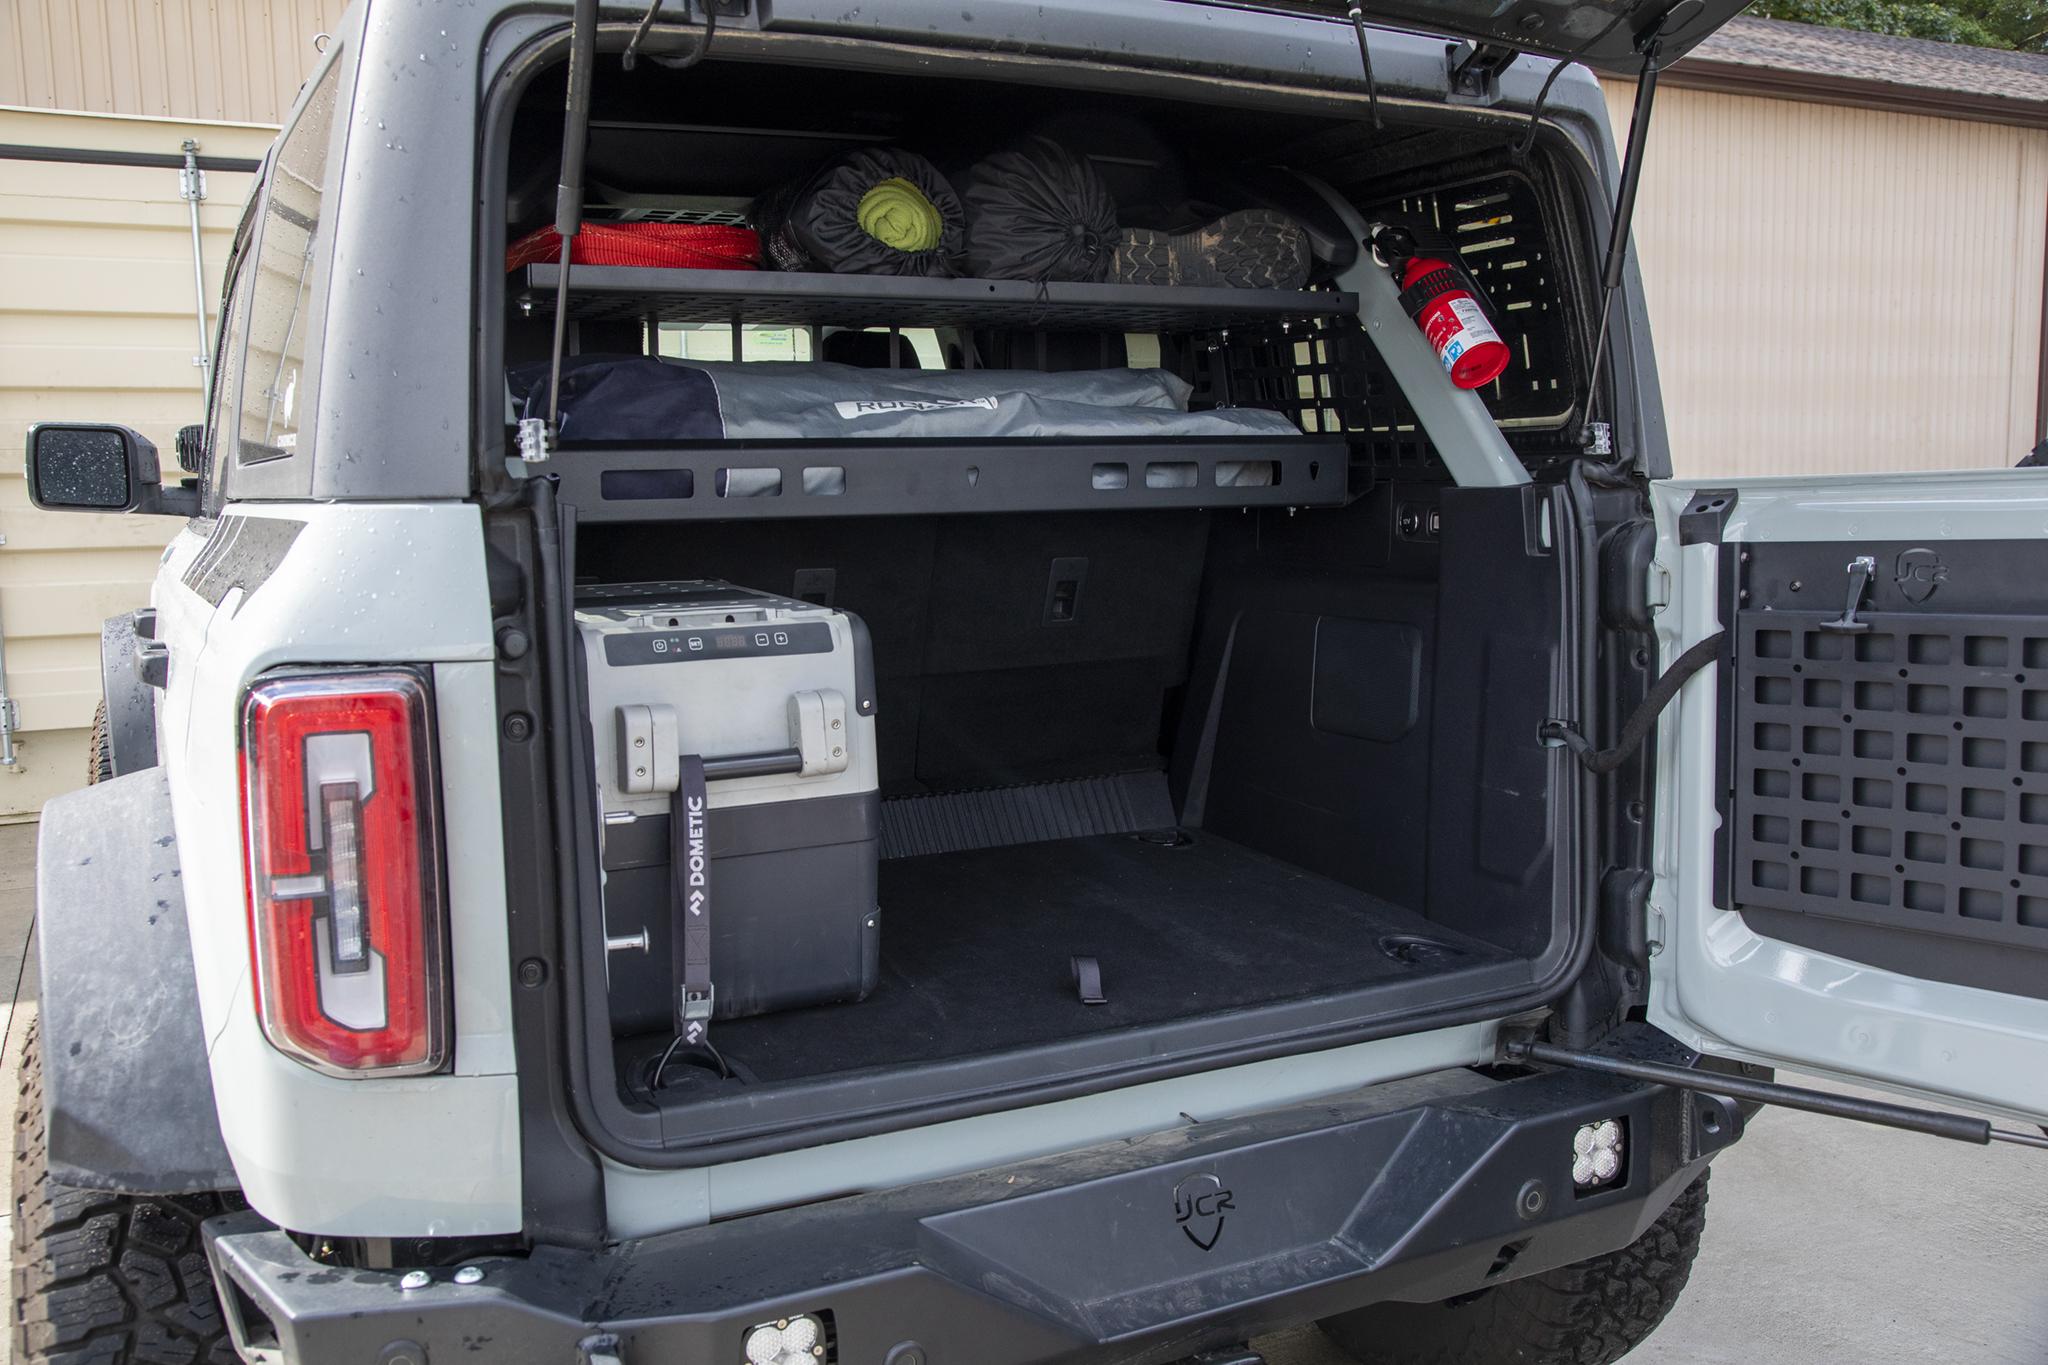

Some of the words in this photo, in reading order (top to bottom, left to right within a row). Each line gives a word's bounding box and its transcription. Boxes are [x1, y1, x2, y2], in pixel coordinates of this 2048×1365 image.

[1894, 562, 1950, 583] JCR
[688, 796, 705, 886] DOMETIC
[1176, 1190, 1236, 1224] JCR
